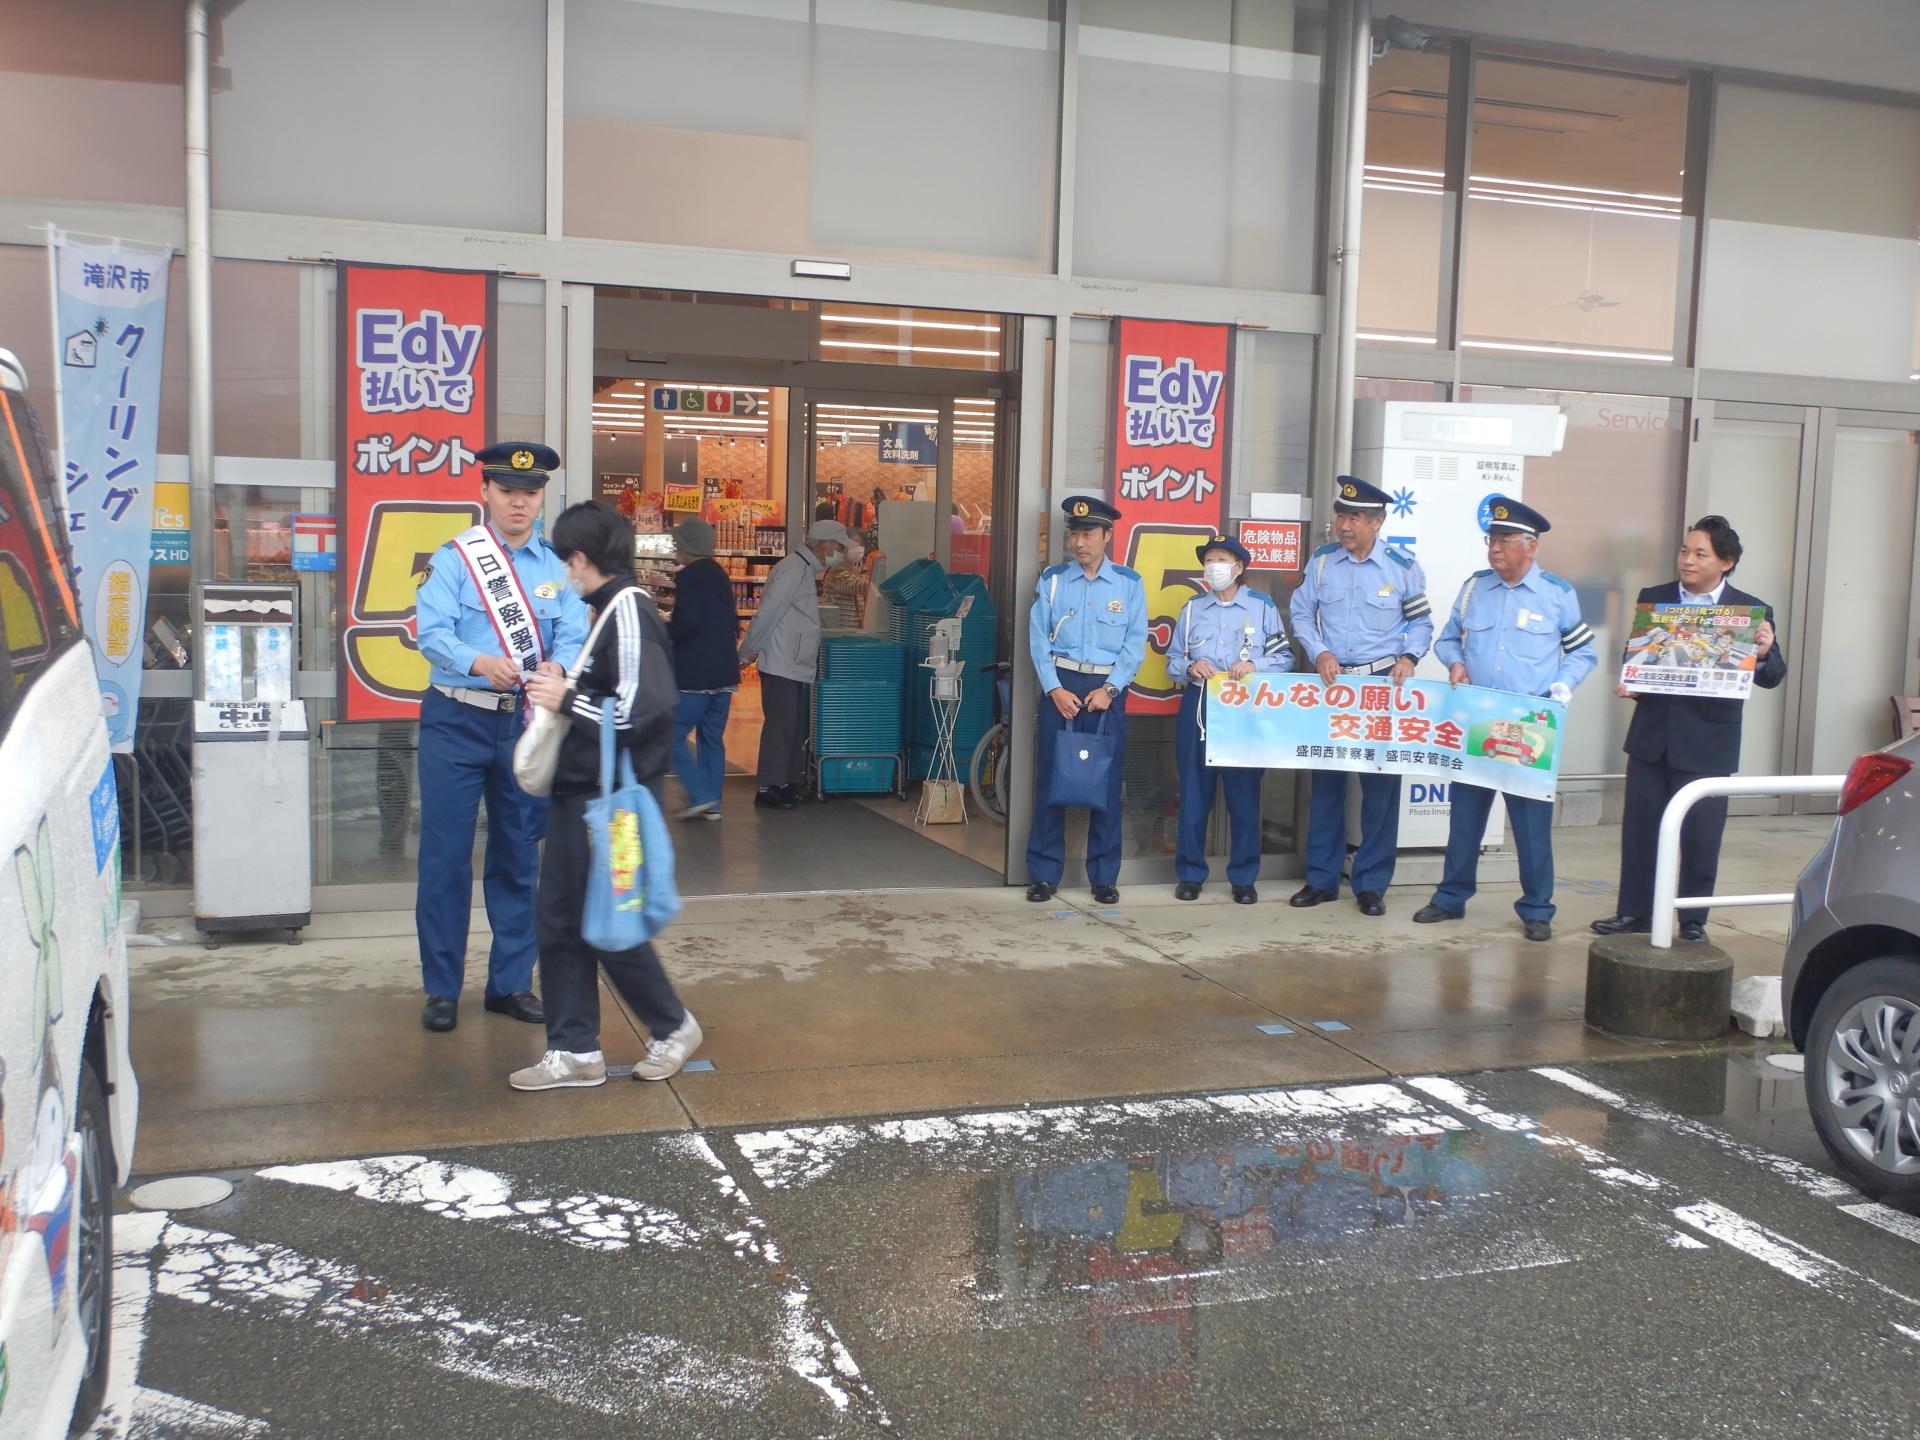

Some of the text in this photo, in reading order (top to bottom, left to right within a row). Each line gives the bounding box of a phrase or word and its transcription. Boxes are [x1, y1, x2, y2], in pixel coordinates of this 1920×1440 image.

[82, 262, 151, 293] 滝沢市
[360, 312, 479, 378] Edy
[365, 370, 469, 408] 払いで
[1127, 358, 1221, 417] Edy
[101, 323, 145, 522] クーリング
[887, 422, 893, 431] 1
[1129, 408, 1212, 444] 払いで
[355, 435, 477, 475] ポイント
[1120, 465, 1216, 502] ポイント
[1243, 529, 1297, 546] 危険物品
[344, 500, 484, 703] 5
[1121, 523, 1219, 700] 5
[1219, 681, 1426, 713] みんなの願い
[1329, 713, 1464, 751] 交通安全
[1296, 745, 1464, 771] 盛岡西警察署 盛岡安管部会
[1410, 783, 1451, 803] DN
[1408, 808, 1451, 817] Photo Imag
